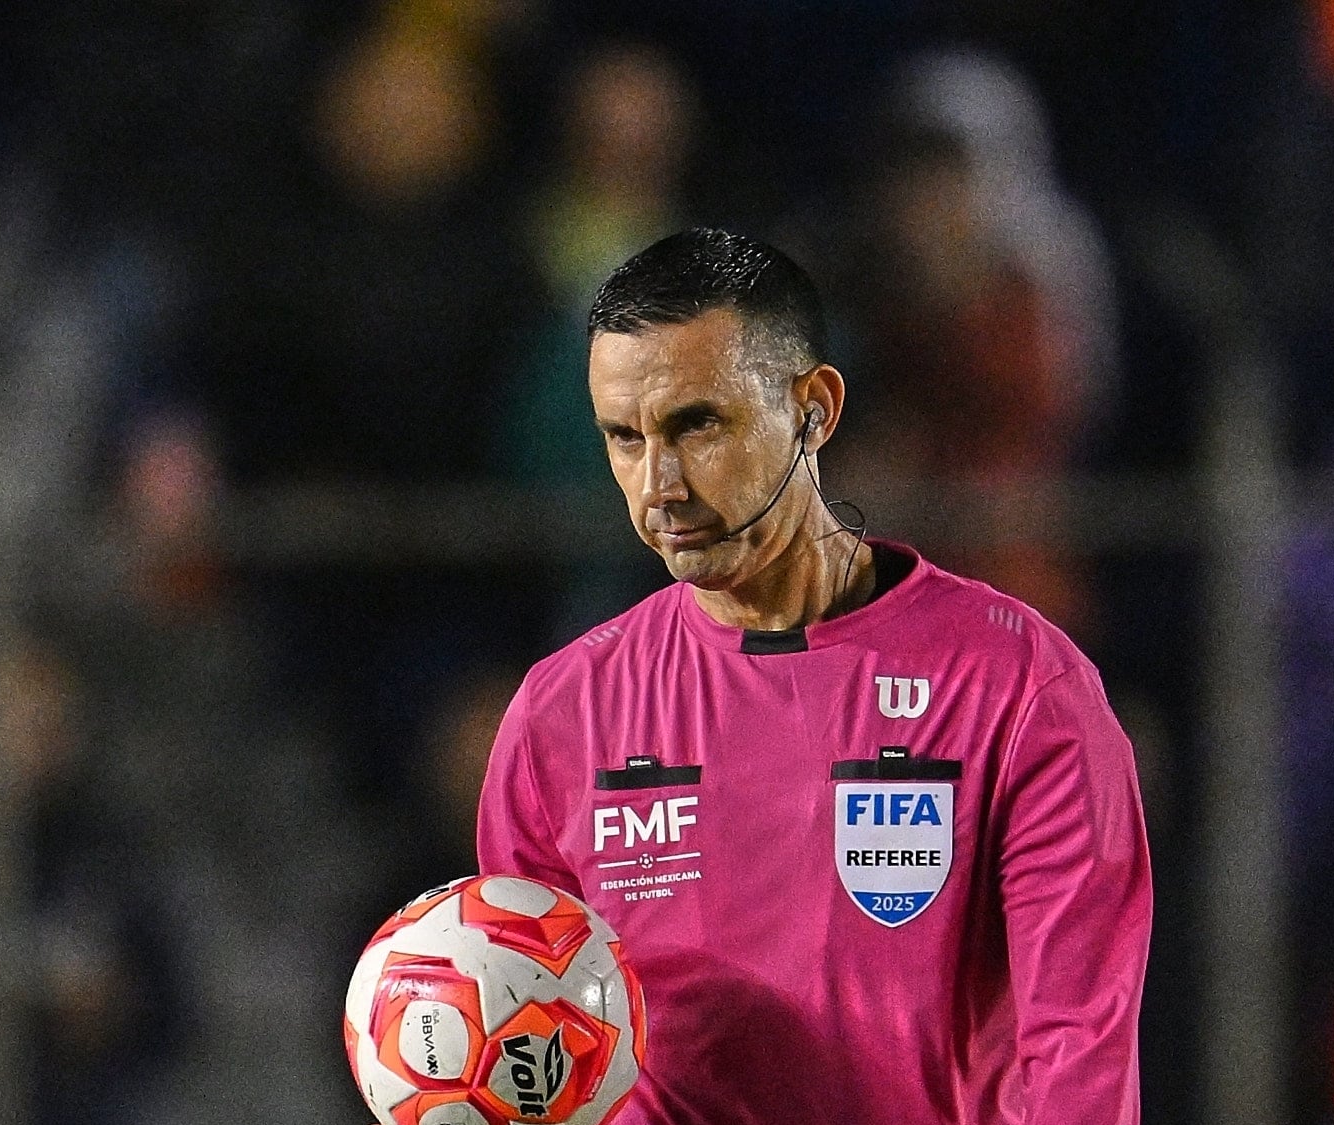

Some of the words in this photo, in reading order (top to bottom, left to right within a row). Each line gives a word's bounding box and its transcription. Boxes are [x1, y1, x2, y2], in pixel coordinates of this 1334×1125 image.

[846, 793, 941, 825] FIFA
[594, 796, 699, 852] FMF
[846, 849, 941, 867] REFEREE
[655, 870, 702, 883] MEXICANA
[624, 892, 638, 901] DE
[639, 888, 673, 900] FUTBOL
[872, 896, 915, 912] 2025
[421, 1015, 435, 1054] BBVA
